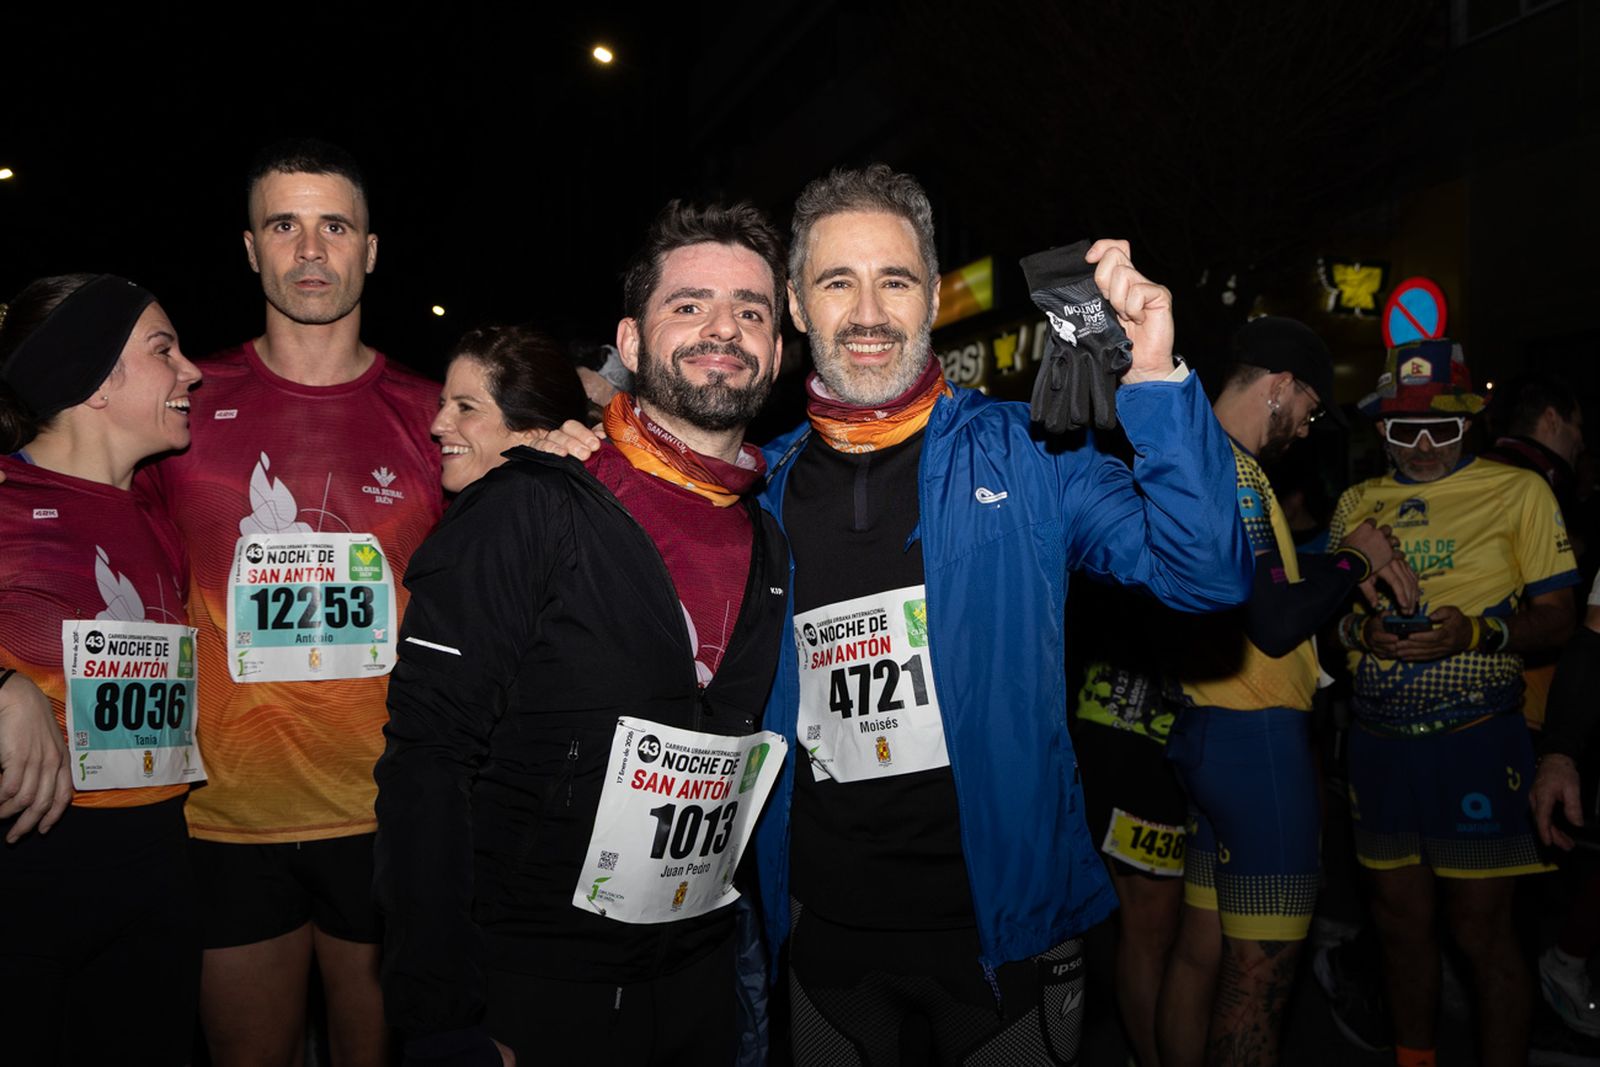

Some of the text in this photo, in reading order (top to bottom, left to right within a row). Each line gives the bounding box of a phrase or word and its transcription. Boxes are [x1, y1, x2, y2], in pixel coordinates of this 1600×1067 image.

[1064, 302, 1102, 316] ANTÓN
[1083, 311, 1104, 322] SAN
[646, 422, 662, 437] SAN
[247, 547, 263, 557] 43
[1436, 539, 1455, 552] DE
[318, 550, 334, 563] DE
[248, 564, 335, 583] SAN ANTÓN
[250, 586, 374, 630] 12253
[819, 614, 888, 644] NOCHE DE
[86, 636, 104, 647] 43
[108, 641, 169, 657] NOCHE DE
[811, 647, 832, 670] SAN
[835, 633, 892, 663] ANTÓN
[84, 660, 120, 678] SAN
[122, 657, 168, 678] ANTÓN
[829, 654, 929, 720] 4721
[94, 682, 186, 731] 8036
[860, 718, 898, 733] Moisés
[134, 735, 157, 745] Tania
[638, 740, 660, 756] 43
[661, 751, 740, 776] NOCHE DE
[617, 776, 623, 784] 17
[631, 769, 676, 796] SAN
[676, 776, 732, 801] ANTÓN
[649, 801, 738, 860] 1013
[1130, 826, 1185, 860] 1438
[660, 863, 711, 878] Juan Pedro
